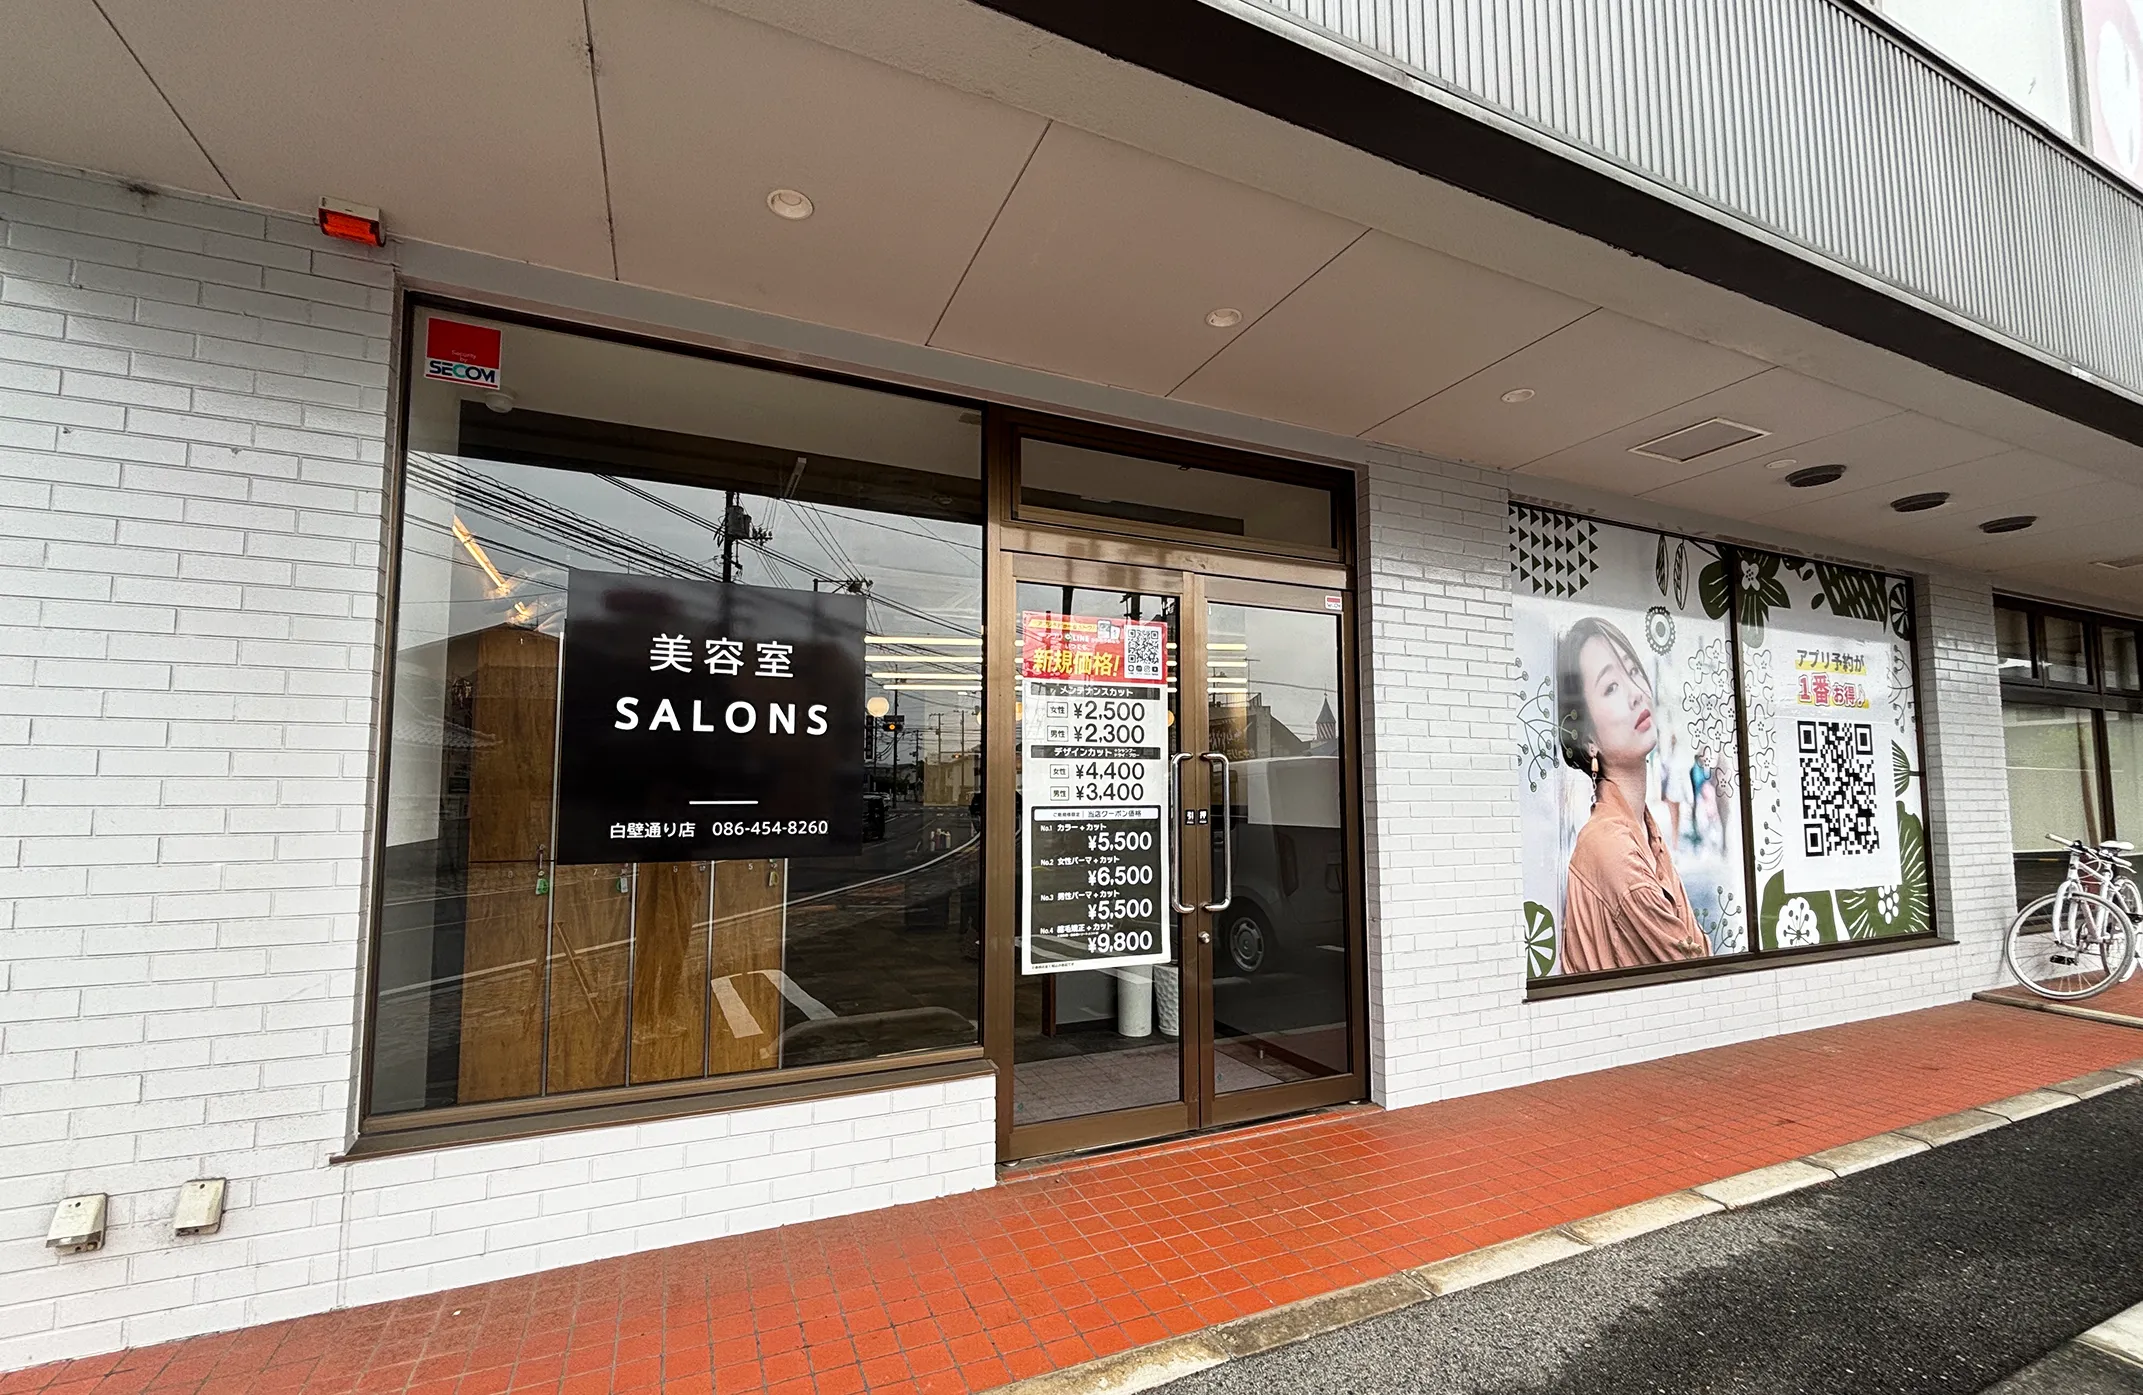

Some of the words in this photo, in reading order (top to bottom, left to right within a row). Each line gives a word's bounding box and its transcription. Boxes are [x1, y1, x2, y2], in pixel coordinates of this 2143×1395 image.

[451, 350, 477, 359] Security
[429, 360, 496, 383] SECOM
[649, 633, 794, 678] 美容室
[1797, 649, 1865, 673] アプリ予約が
[1060, 685, 1133, 698] メンテナンスカット
[614, 696, 829, 735] SALONS
[1050, 706, 1066, 715] 女性
[1073, 700, 1145, 721] ¥2,500
[1050, 730, 1066, 739] 男性
[1073, 723, 1145, 744] ¥2,300
[1054, 747, 1112, 758] デザインカット
[1075, 762, 1145, 780] ¥4,400
[1075, 782, 1144, 801] ¥3,400
[610, 822, 696, 839] 白壁通り店
[712, 820, 829, 836] 086-454-8260
[1087, 831, 1153, 851] ¥5,500
[1087, 865, 1153, 886] ¥6,500
[1087, 898, 1153, 920] ¥5,500
[1040, 927, 1054, 935] No.4
[1087, 930, 1153, 953] ¥9,800
